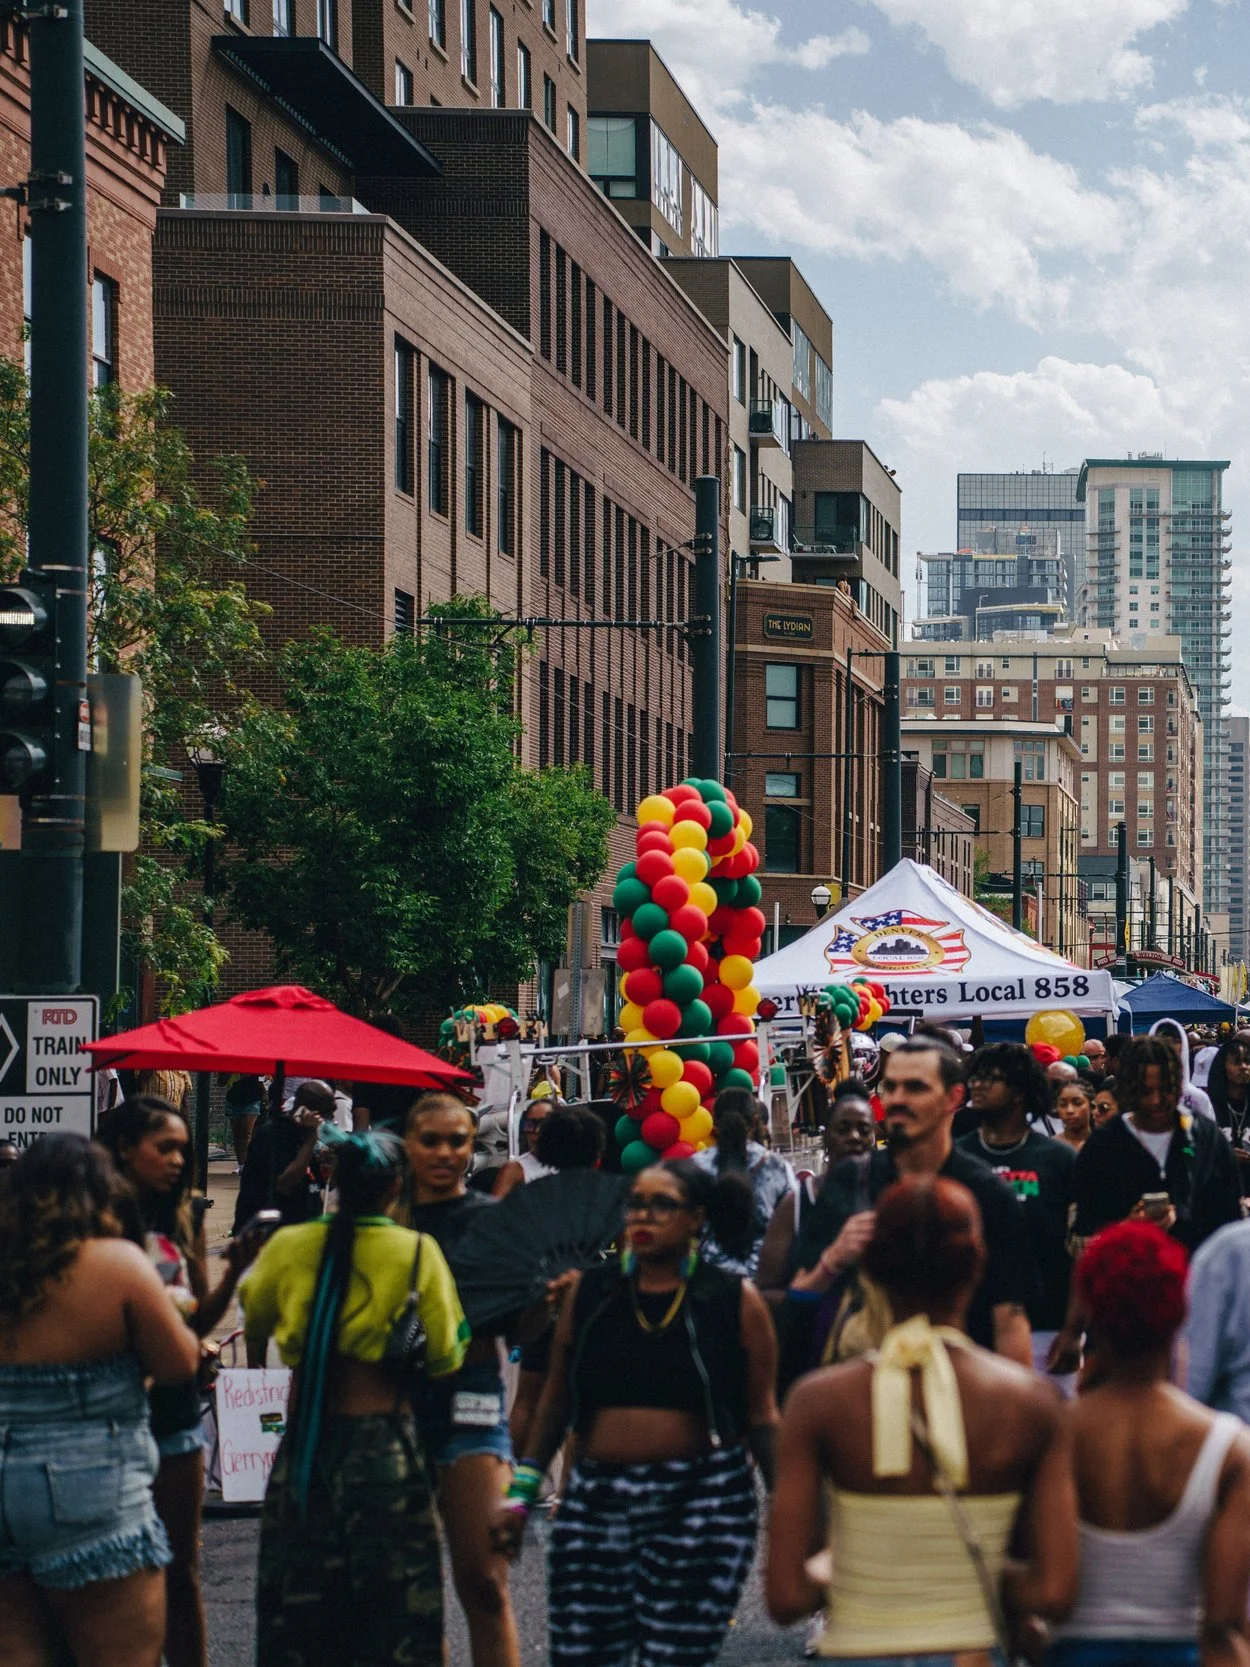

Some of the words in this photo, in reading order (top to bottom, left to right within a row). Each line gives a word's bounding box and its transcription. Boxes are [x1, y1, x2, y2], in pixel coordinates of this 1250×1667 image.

[768, 619, 781, 630] THE
[783, 621, 811, 632] LYDIAN
[874, 925, 924, 939] DENVER
[958, 978, 1026, 1002] Local
[1034, 975, 1090, 998] 858
[42, 1008, 78, 1025] RTD
[32, 1036, 87, 1055] TRAIN
[35, 1066, 81, 1086] ONLY
[4, 1107, 26, 1124] DO
[31, 1106, 63, 1124] NOT
